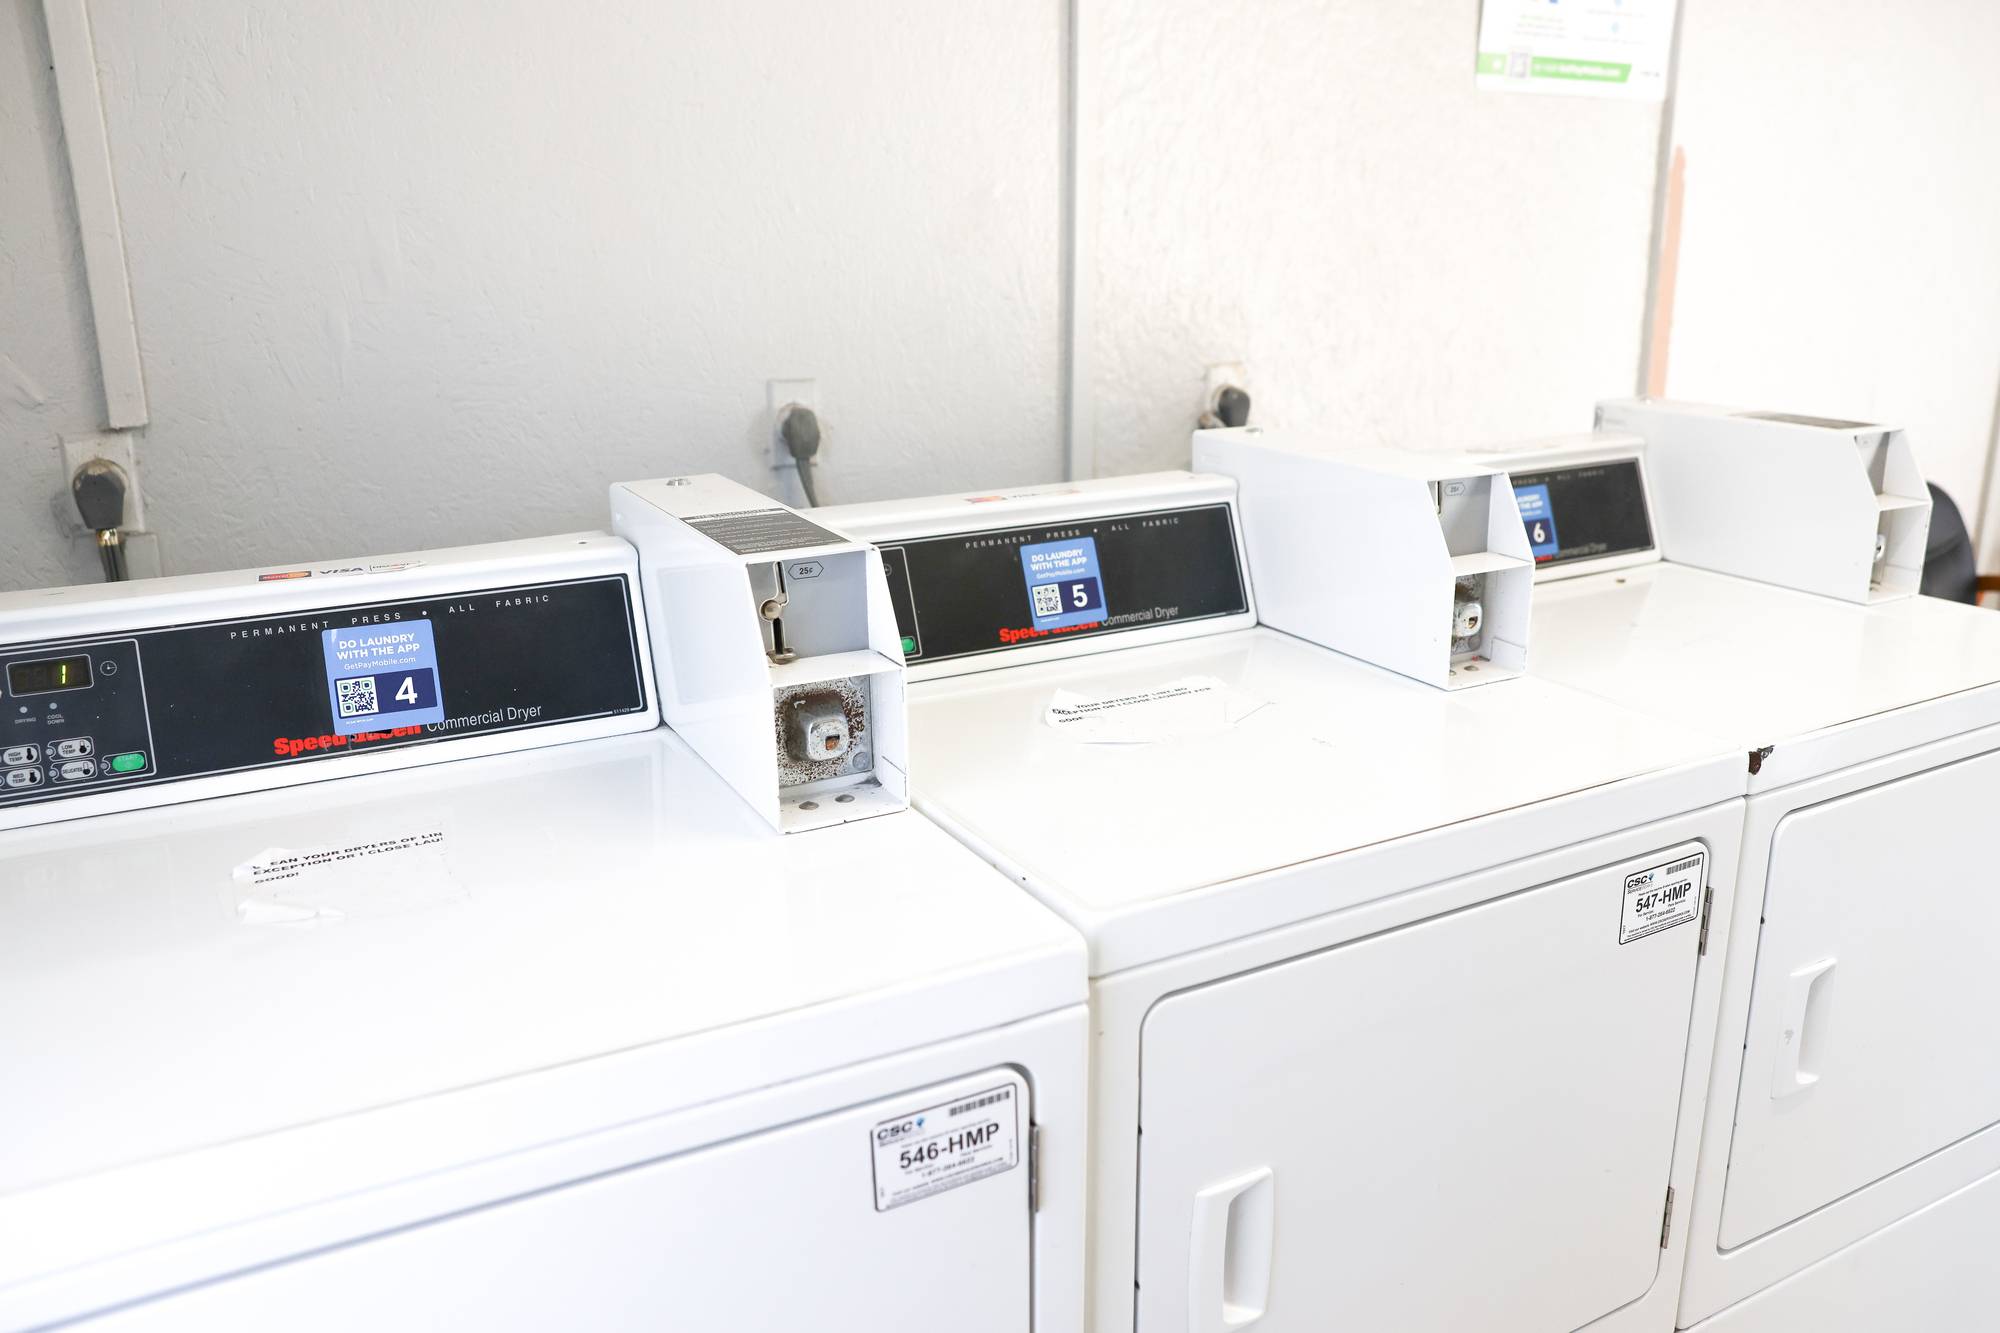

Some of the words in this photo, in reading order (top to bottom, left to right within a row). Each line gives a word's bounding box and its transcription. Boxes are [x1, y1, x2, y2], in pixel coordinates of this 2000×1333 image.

[965, 535, 1032, 549] PERMANENT
[1046, 529, 1080, 539] PRESS
[1111, 523, 1130, 531] ALL
[1142, 517, 1179, 528] FABRIC
[1533, 522, 1545, 543] 6
[1030, 562, 1053, 571] WITH
[1054, 559, 1070, 568] THE
[1072, 557, 1088, 566] APP
[1031, 554, 1044, 563] DO
[1045, 549, 1083, 561] LAUNDRY
[320, 567, 364, 575] VISA
[1072, 584, 1088, 608] 5
[230, 620, 329, 639] PERMANENT
[351, 612, 401, 625] PRESS
[448, 603, 475, 614] ALL
[495, 594, 550, 608] FABRIC
[1154, 606, 1179, 619] Dryer
[339, 639, 357, 650] DO
[360, 632, 415, 647] LAUNDRY
[336, 649, 369, 660] WITH
[372, 646, 394, 657] THE
[397, 643, 420, 654] APP
[344, 657, 416, 671] GetPayMobile.com
[394, 676, 418, 705] 4
[426, 709, 503, 732] Commercial
[507, 705, 543, 722] Dryer
[253, 858, 332, 875] EXCEPTION
[368, 843, 411, 854] CLOSE
[303, 851, 340, 860] YOUR
[344, 840, 397, 853] DRYERS
[254, 871, 299, 884] GOOD!
[1627, 875, 1648, 889] CSC
[1635, 882, 1692, 913] 547-HMP
[877, 1121, 913, 1140] CSC
[900, 1123, 1000, 1169] 546-HMP
